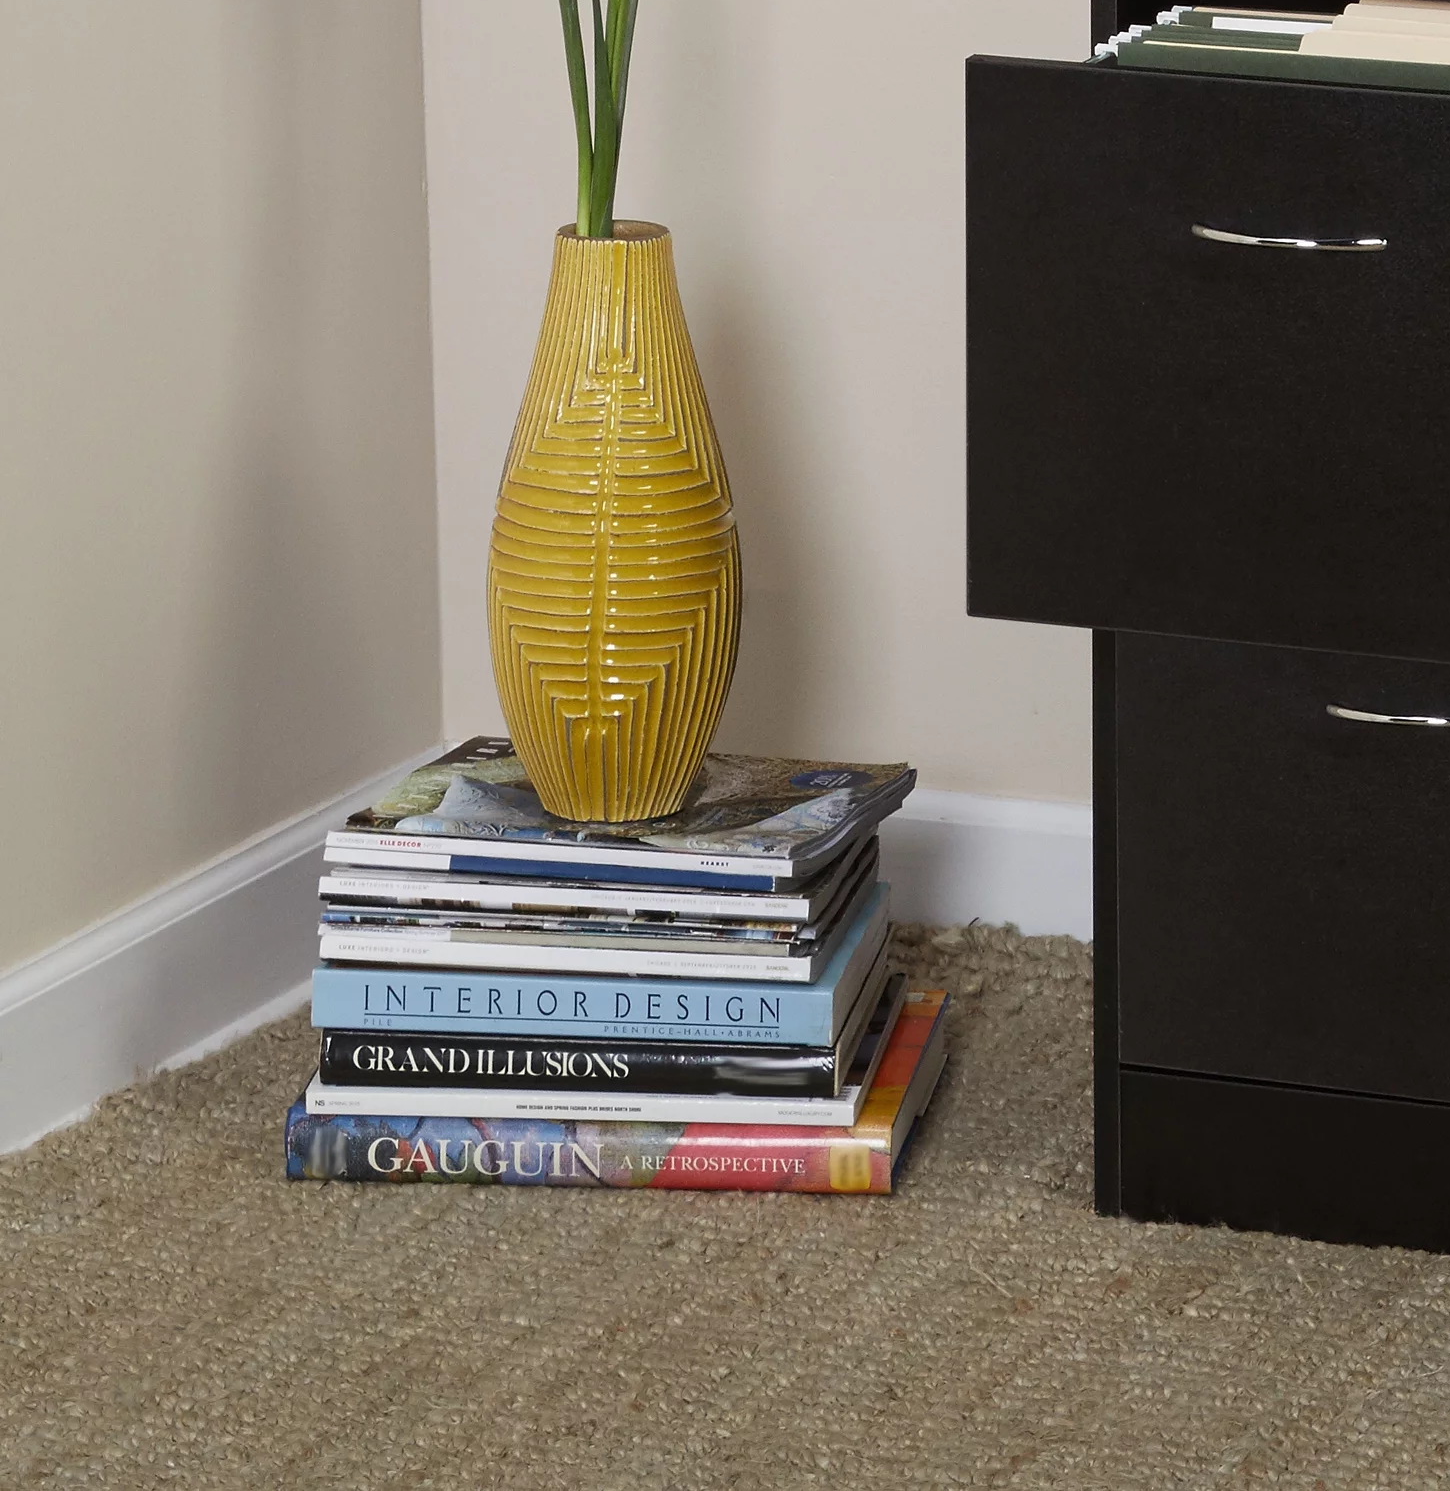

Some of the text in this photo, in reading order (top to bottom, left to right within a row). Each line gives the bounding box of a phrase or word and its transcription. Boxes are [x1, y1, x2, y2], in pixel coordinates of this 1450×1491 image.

[379, 839, 395, 847] ELLE
[363, 984, 781, 1023] INTERIOR DESIGN
[363, 1018, 392, 1027] PILE
[352, 1044, 629, 1079] GRAND ILLUSIONS
[314, 1099, 326, 1107] NS
[367, 1136, 806, 1178] GAUGUIN A RETROSPECTIVE
